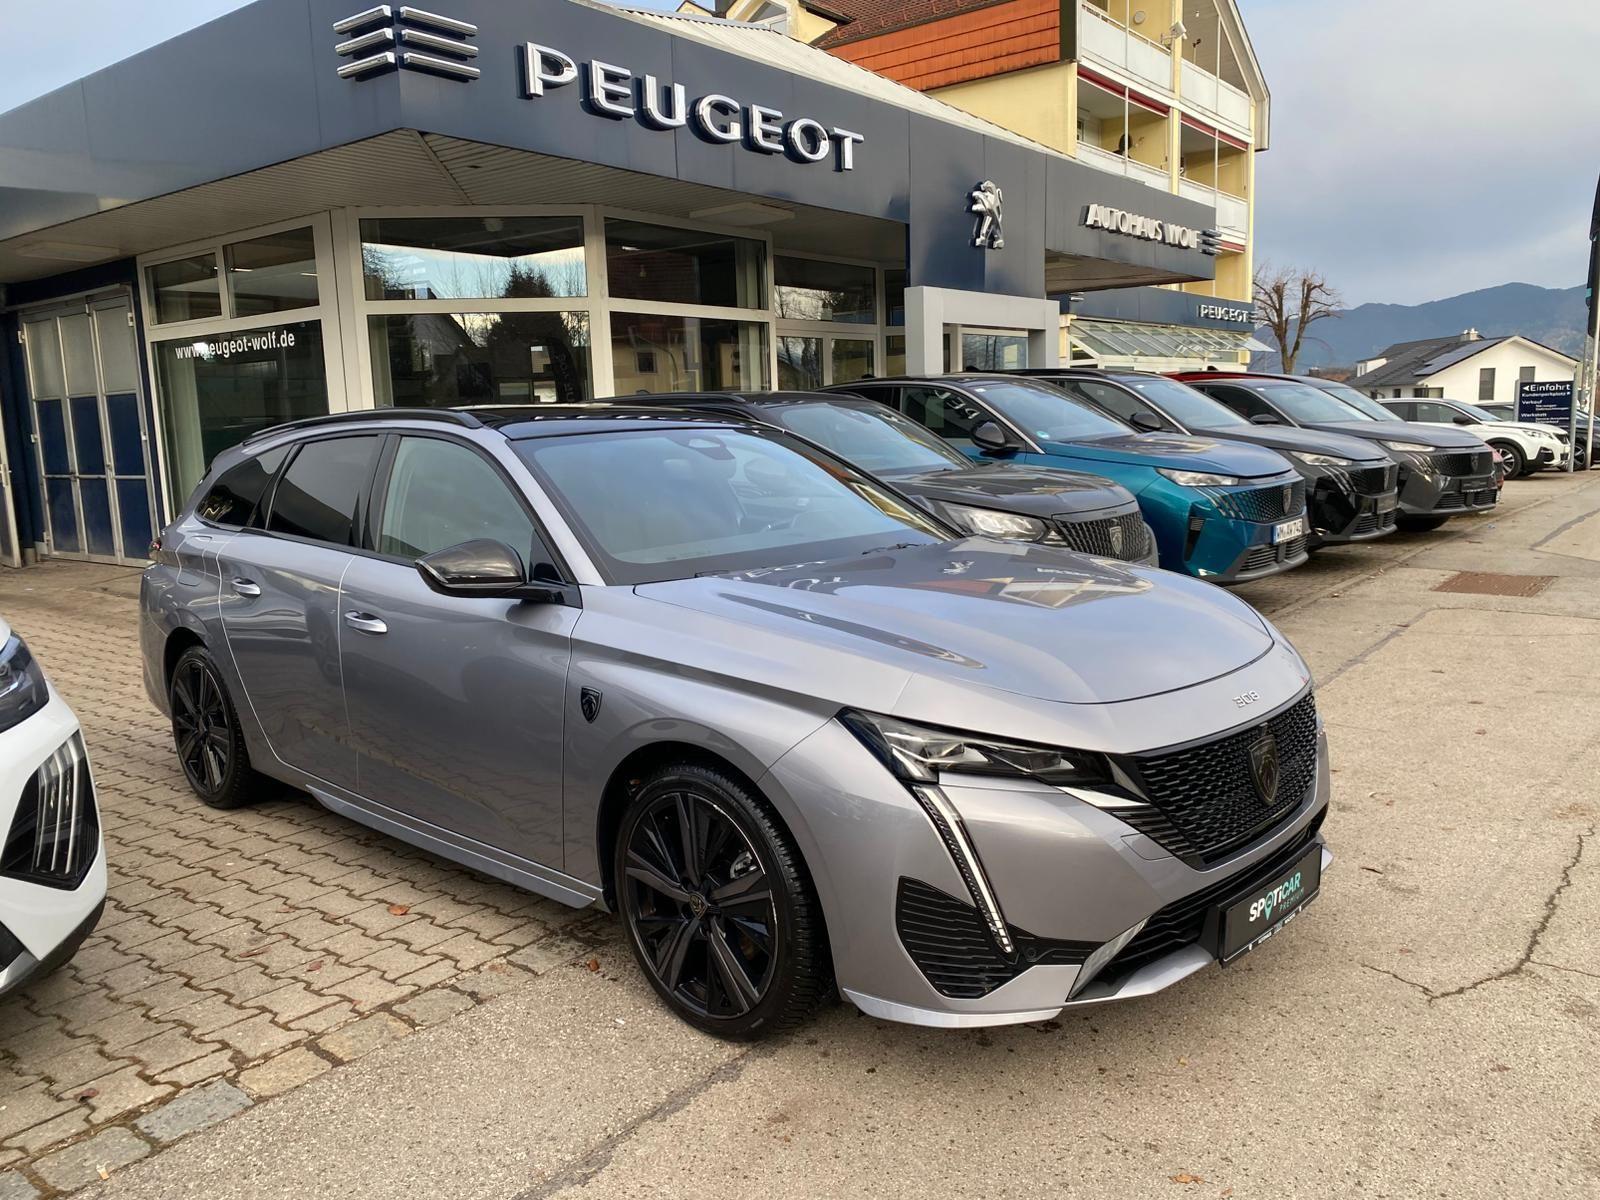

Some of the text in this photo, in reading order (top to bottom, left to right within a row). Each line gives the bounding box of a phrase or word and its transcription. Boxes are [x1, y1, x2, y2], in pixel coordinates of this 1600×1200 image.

[524, 41, 864, 171] PEUGEOT
[1086, 203, 1163, 240] AUTOHAUS
[1200, 304, 1248, 323] PEUGEOT
[175, 330, 295, 360] wwweugeot-wolf.de
[1232, 690, 1260, 708] 308
